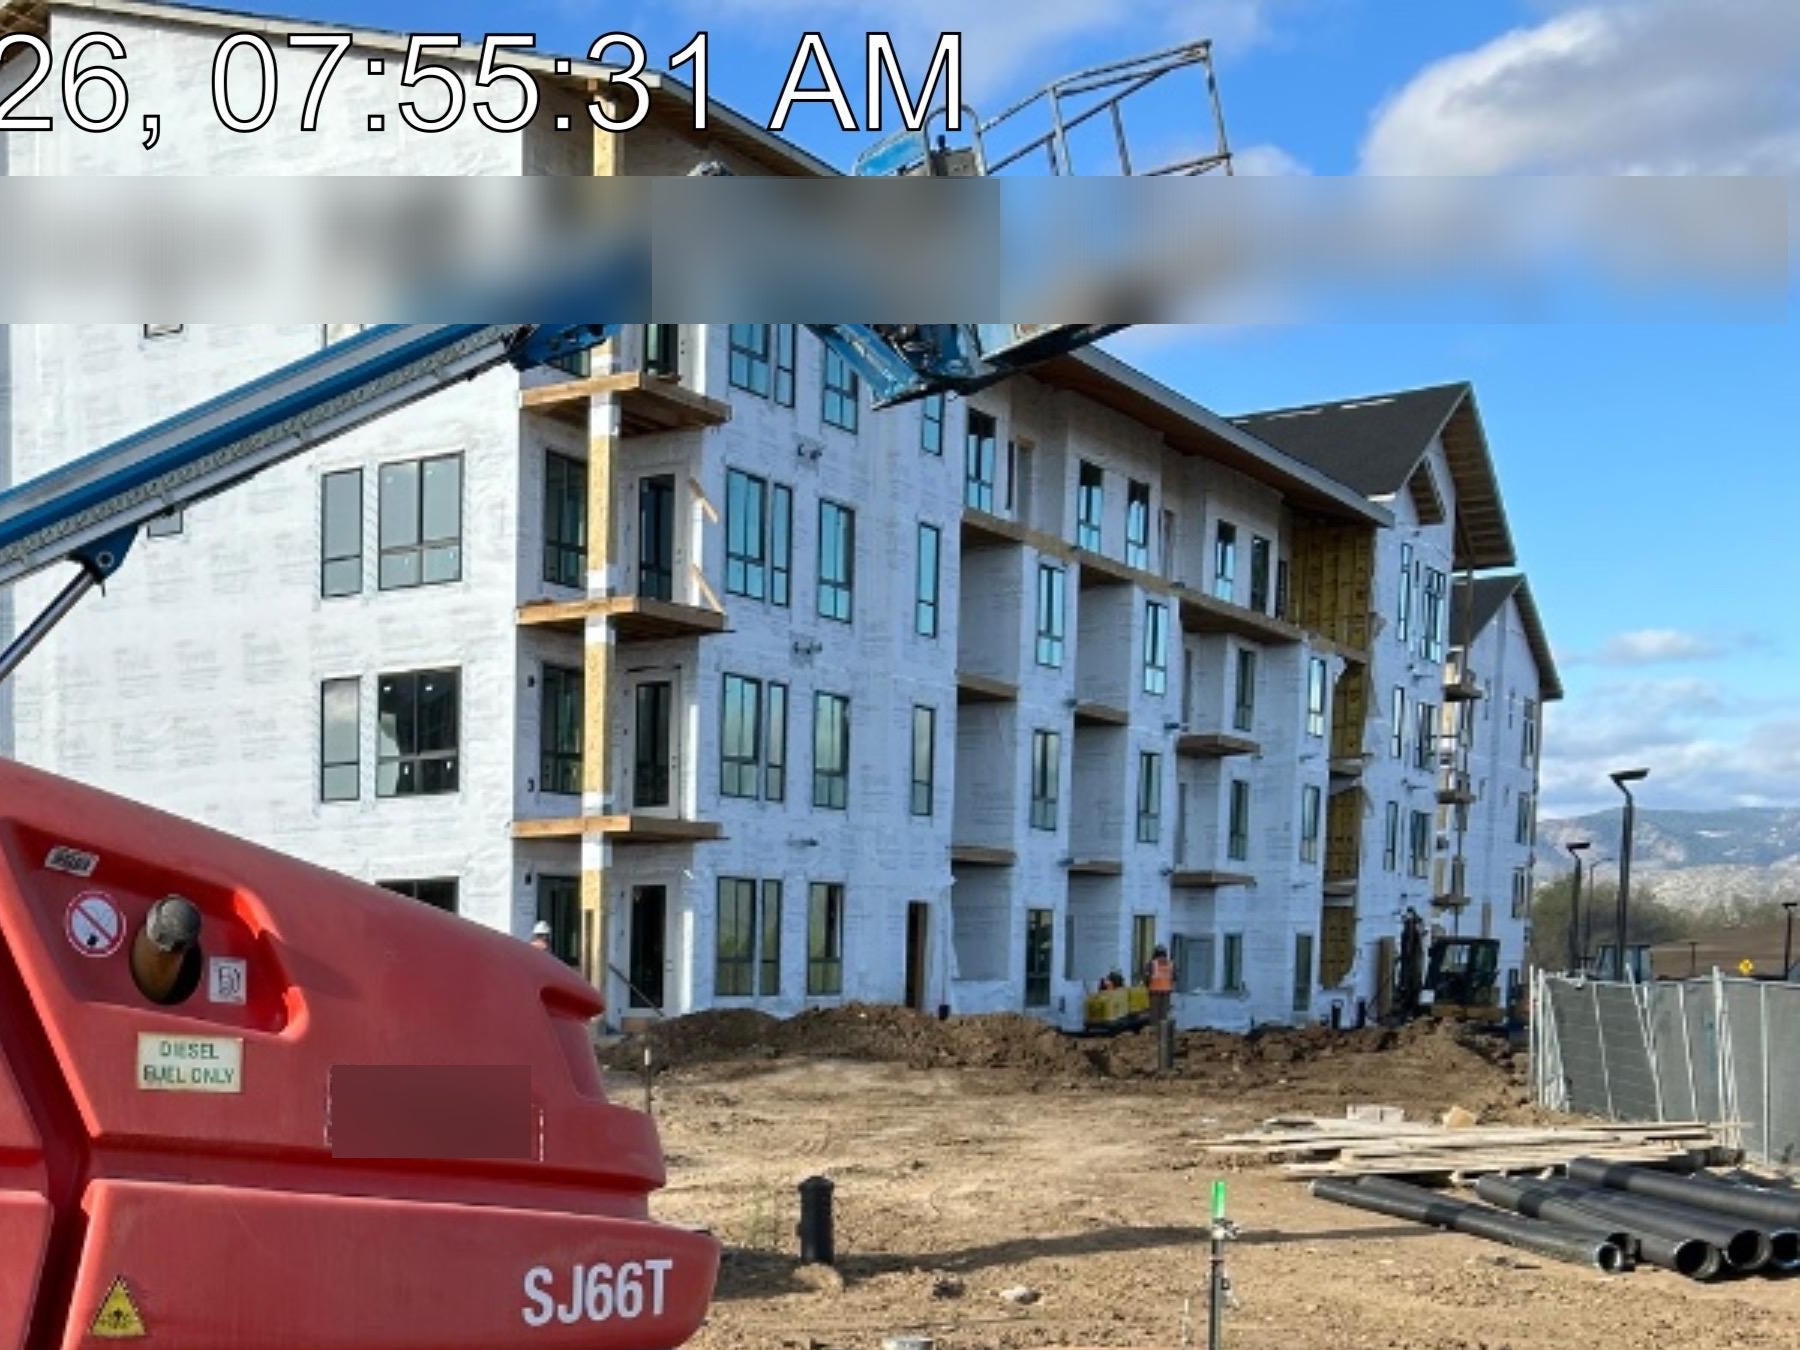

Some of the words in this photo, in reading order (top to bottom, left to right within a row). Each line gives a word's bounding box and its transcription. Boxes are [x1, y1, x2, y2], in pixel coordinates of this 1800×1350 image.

[159, 1039, 220, 1060] DIESEL
[143, 1064, 187, 1085] FUEL
[191, 1067, 235, 1085] ONLY
[521, 1258, 674, 1327] SJ66T
